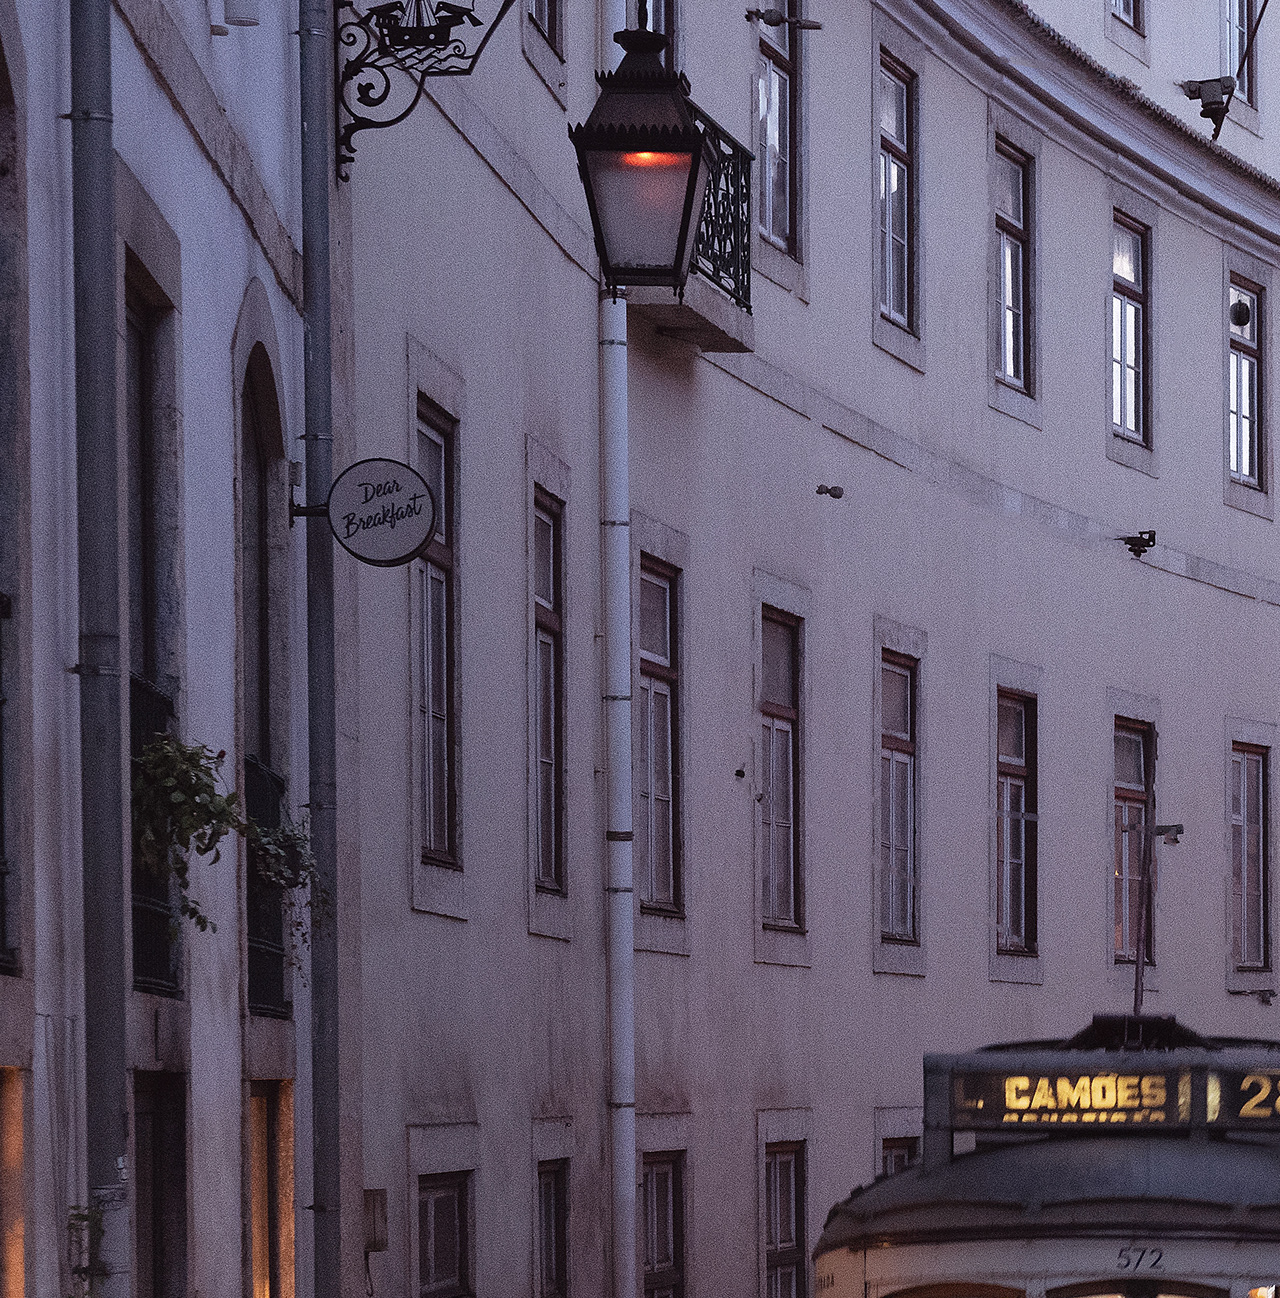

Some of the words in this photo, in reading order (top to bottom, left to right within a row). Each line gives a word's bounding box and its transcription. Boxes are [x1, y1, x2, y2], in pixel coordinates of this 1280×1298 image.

[357, 479, 402, 504] Dear
[342, 493, 426, 539] Breakfast
[1116, 1246, 1164, 1272] 572
